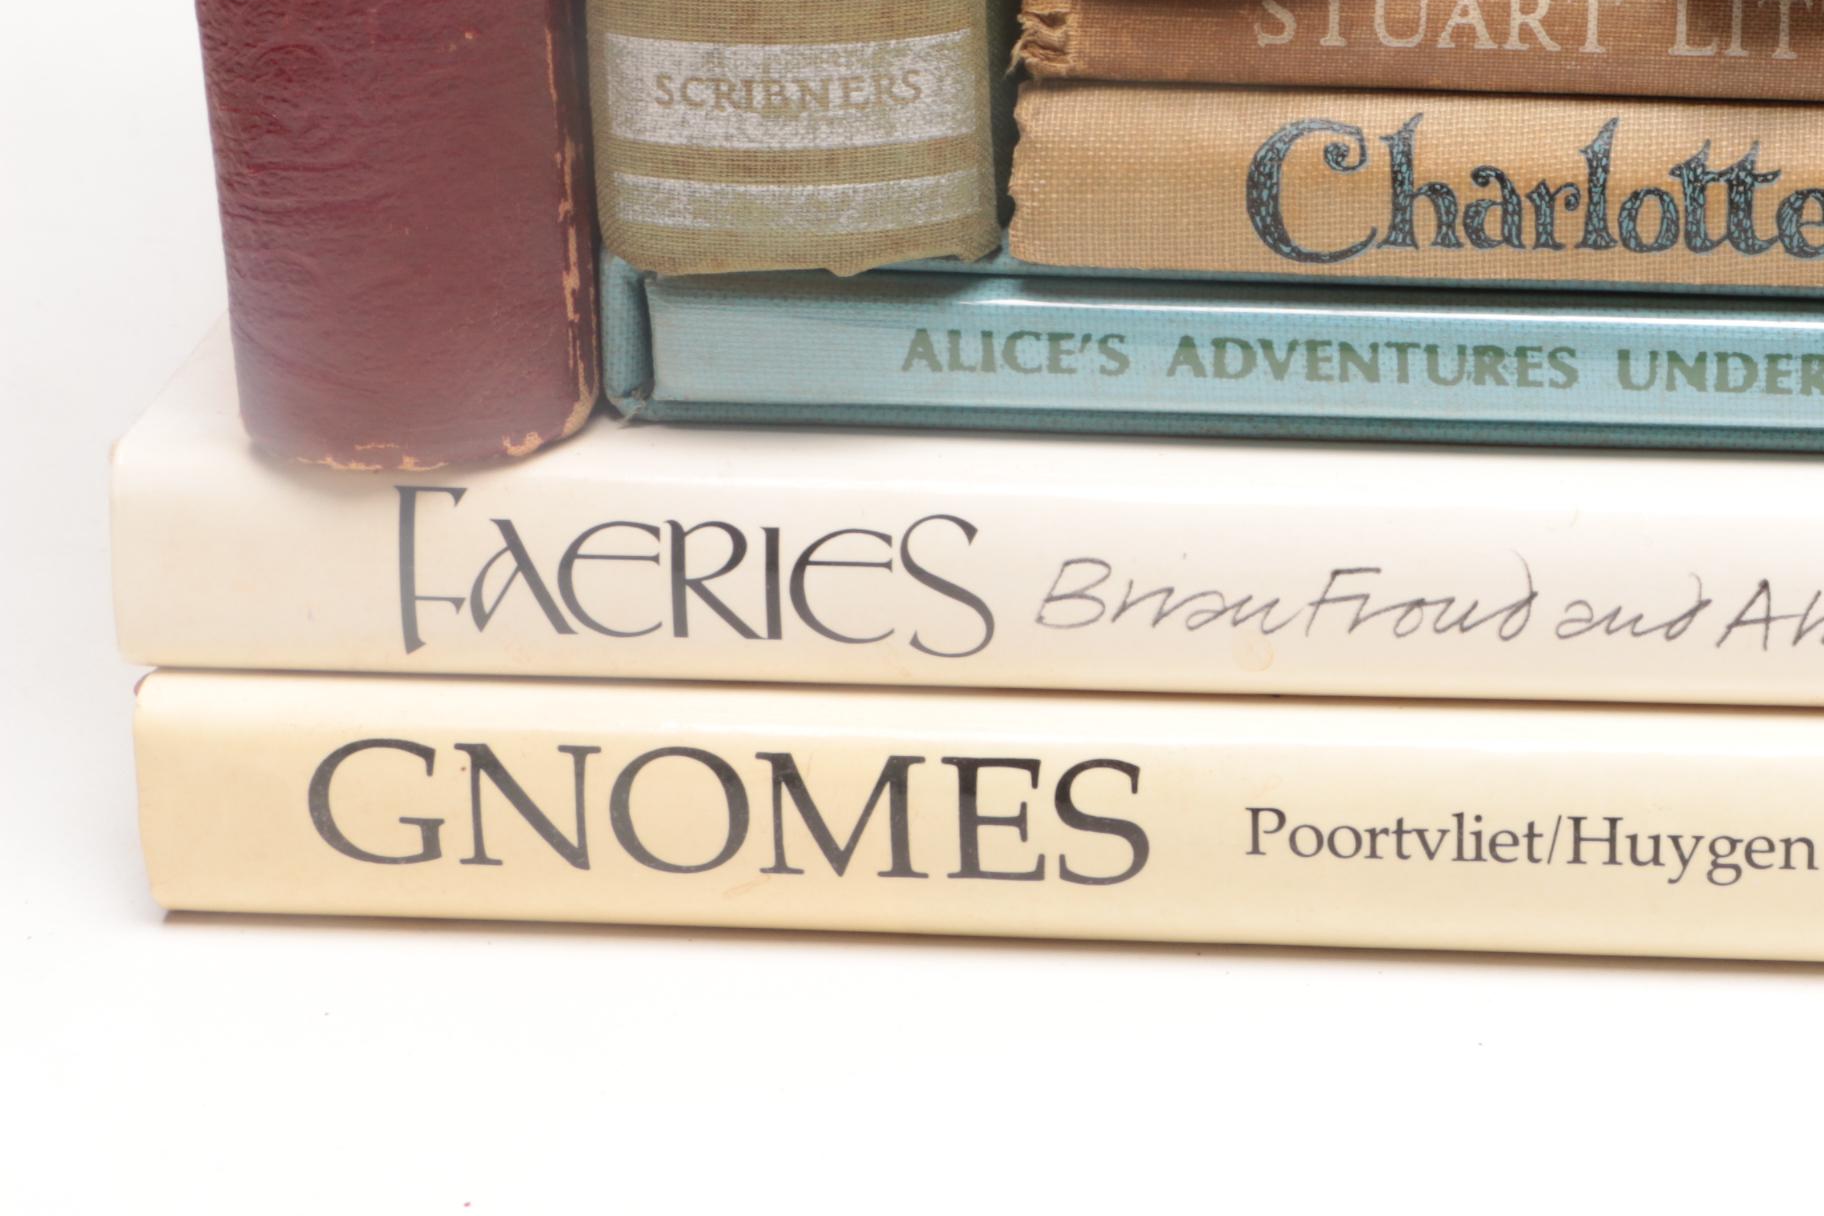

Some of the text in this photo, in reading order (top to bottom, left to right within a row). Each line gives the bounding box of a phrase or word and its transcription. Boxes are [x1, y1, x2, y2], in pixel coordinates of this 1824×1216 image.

[900, 327, 1132, 377] ALICE'S
[1165, 334, 1580, 390] ADVENTURES
[394, 483, 997, 658] FAERIES
[1034, 554, 1304, 634] Brian
[1304, 547, 1540, 639] Froud
[1554, 570, 1710, 642] and
[308, 737, 1821, 887] GNOMES Poortvliet/Huygen
